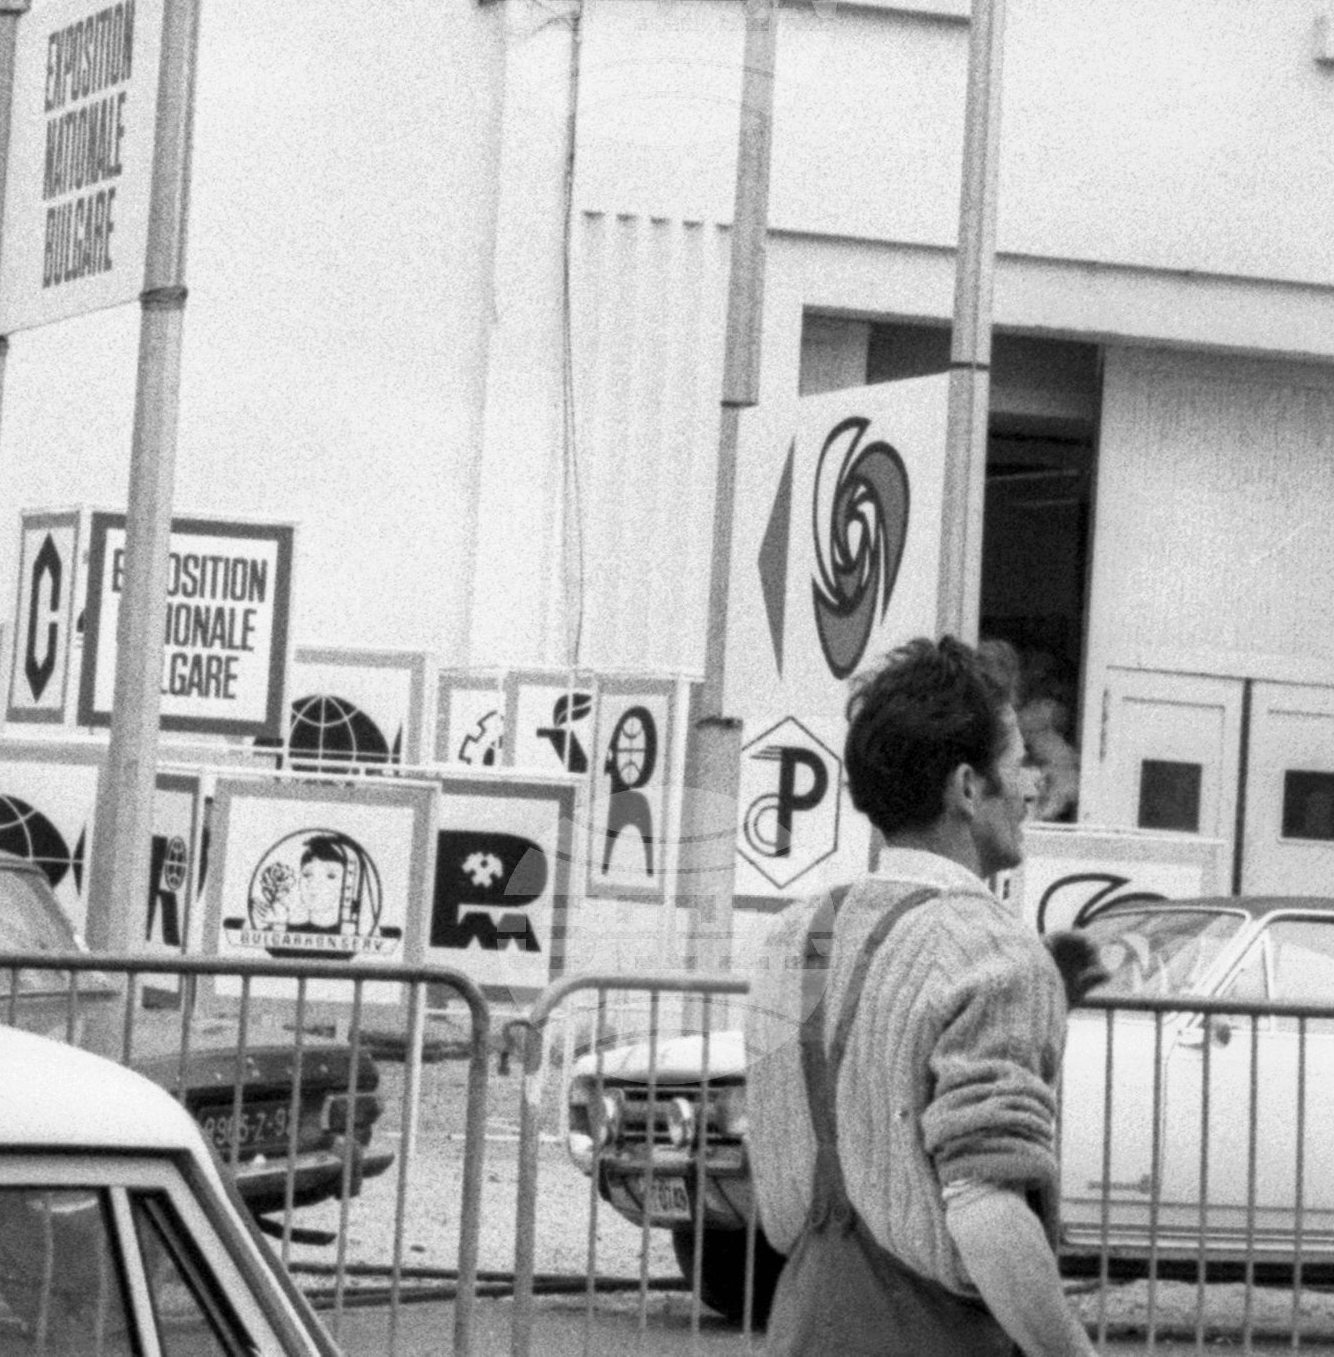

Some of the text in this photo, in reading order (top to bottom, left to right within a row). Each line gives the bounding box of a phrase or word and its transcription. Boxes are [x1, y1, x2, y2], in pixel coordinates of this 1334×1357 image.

[112, 547, 268, 603] EOSITION
[164, 602, 258, 652] IONALE
[161, 652, 240, 700] GARE
